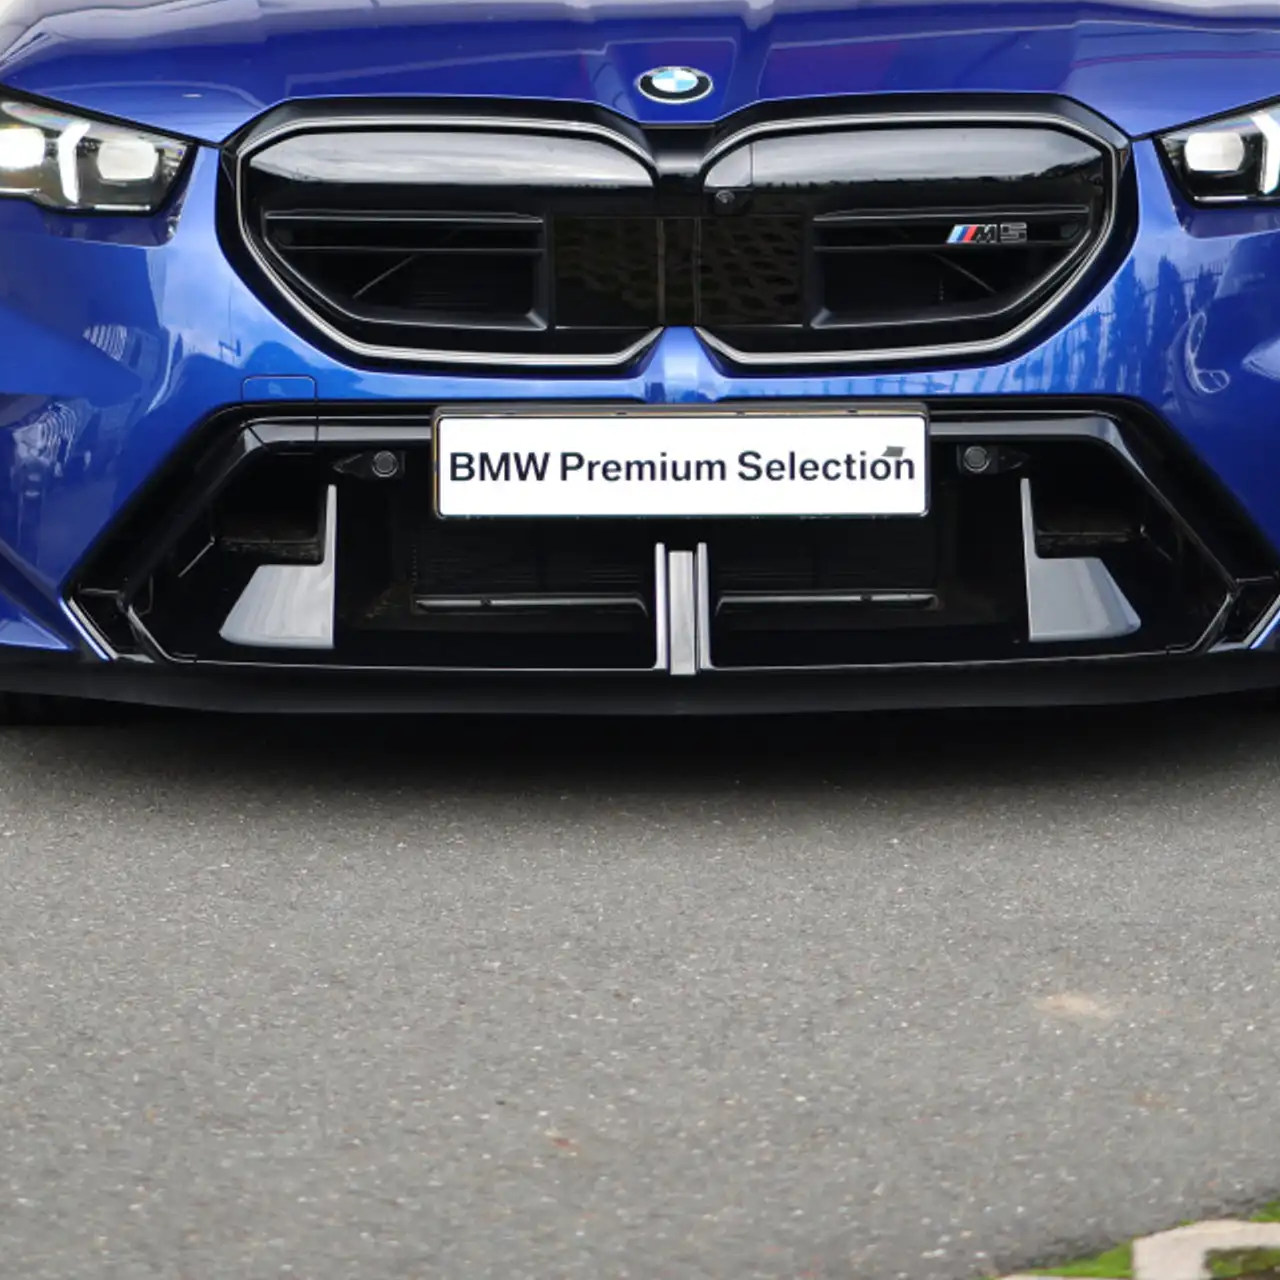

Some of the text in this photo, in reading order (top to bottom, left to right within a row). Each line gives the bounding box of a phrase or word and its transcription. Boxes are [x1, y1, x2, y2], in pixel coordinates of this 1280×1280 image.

[970, 222, 1028, 245] M5
[450, 450, 915, 482] BMW Premium Selection
